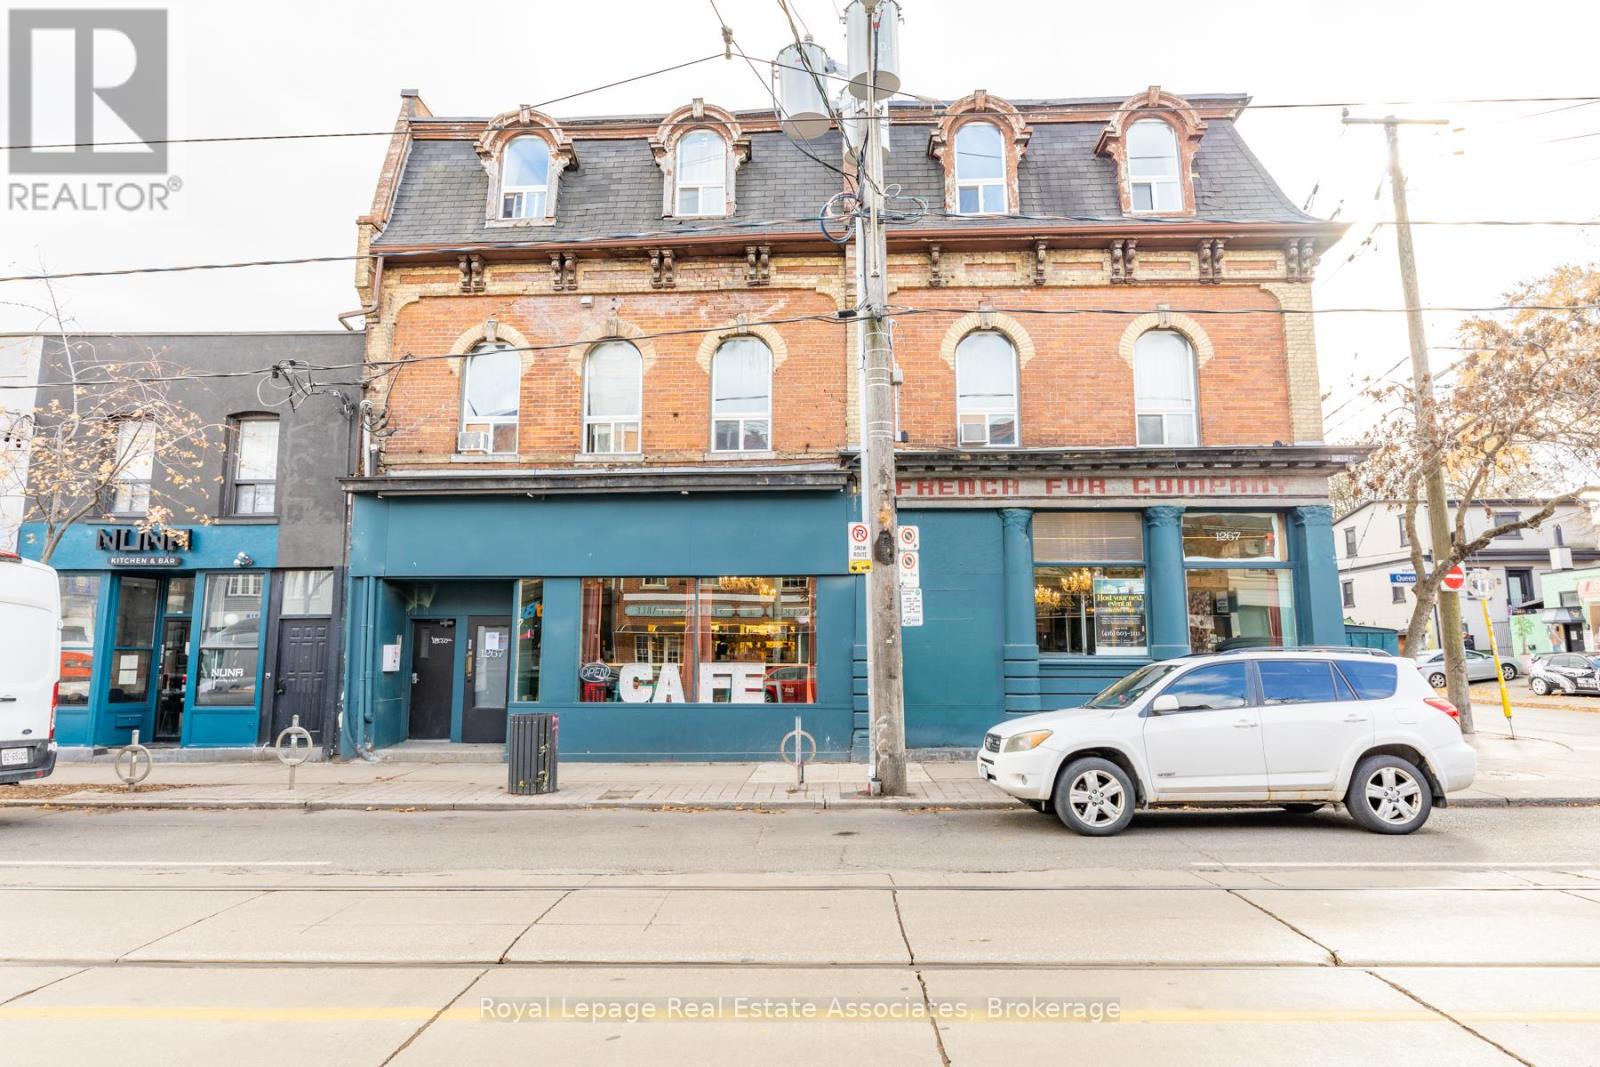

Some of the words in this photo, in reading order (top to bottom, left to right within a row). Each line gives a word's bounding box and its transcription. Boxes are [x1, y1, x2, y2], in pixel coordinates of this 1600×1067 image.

[896, 479, 1019, 495] FRENCH
[1045, 479, 1106, 495] FUR
[1132, 478, 1288, 494] COMPANY
[1216, 531, 1240, 541] 1267
[211, 668, 244, 677] NUNA
[582, 668, 608, 678] OPEN
[619, 662, 766, 704] CAFE
